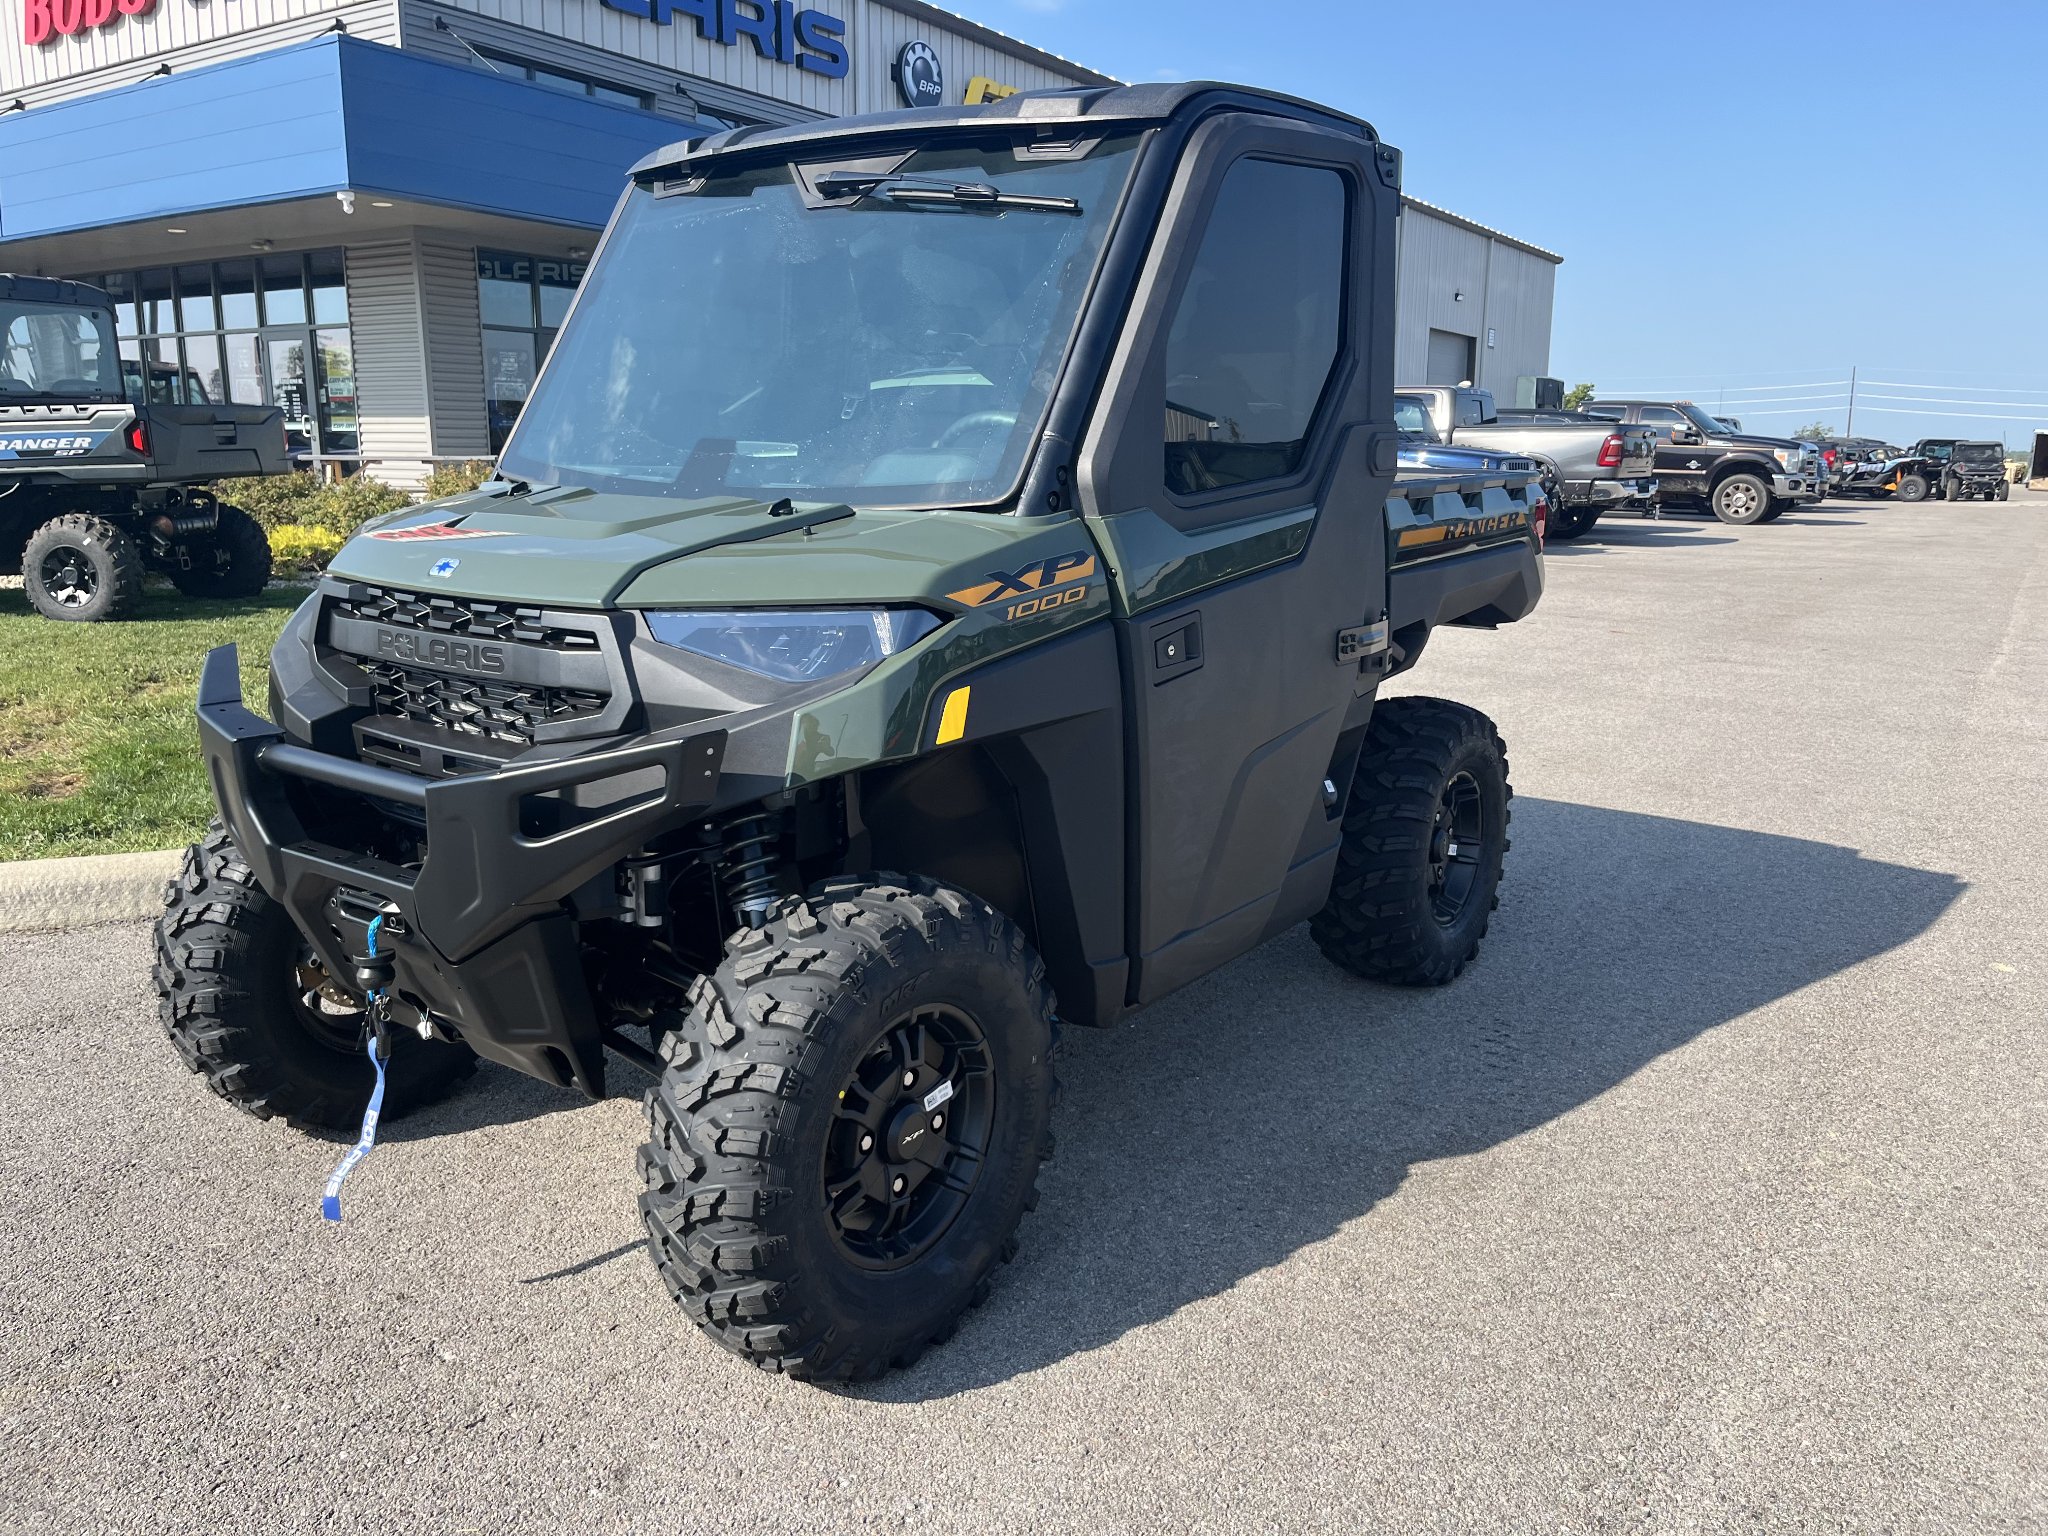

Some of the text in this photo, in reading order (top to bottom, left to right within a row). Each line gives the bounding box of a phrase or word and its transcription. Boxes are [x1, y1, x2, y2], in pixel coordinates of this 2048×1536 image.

[919, 79, 942, 95] BRP
[1444, 511, 1521, 541] RANGER
[978, 550, 1091, 604] XP
[1007, 586, 1085, 621] 1000
[377, 629, 505, 675] POLARIS
[325, 1109, 378, 1197] POLARIS
